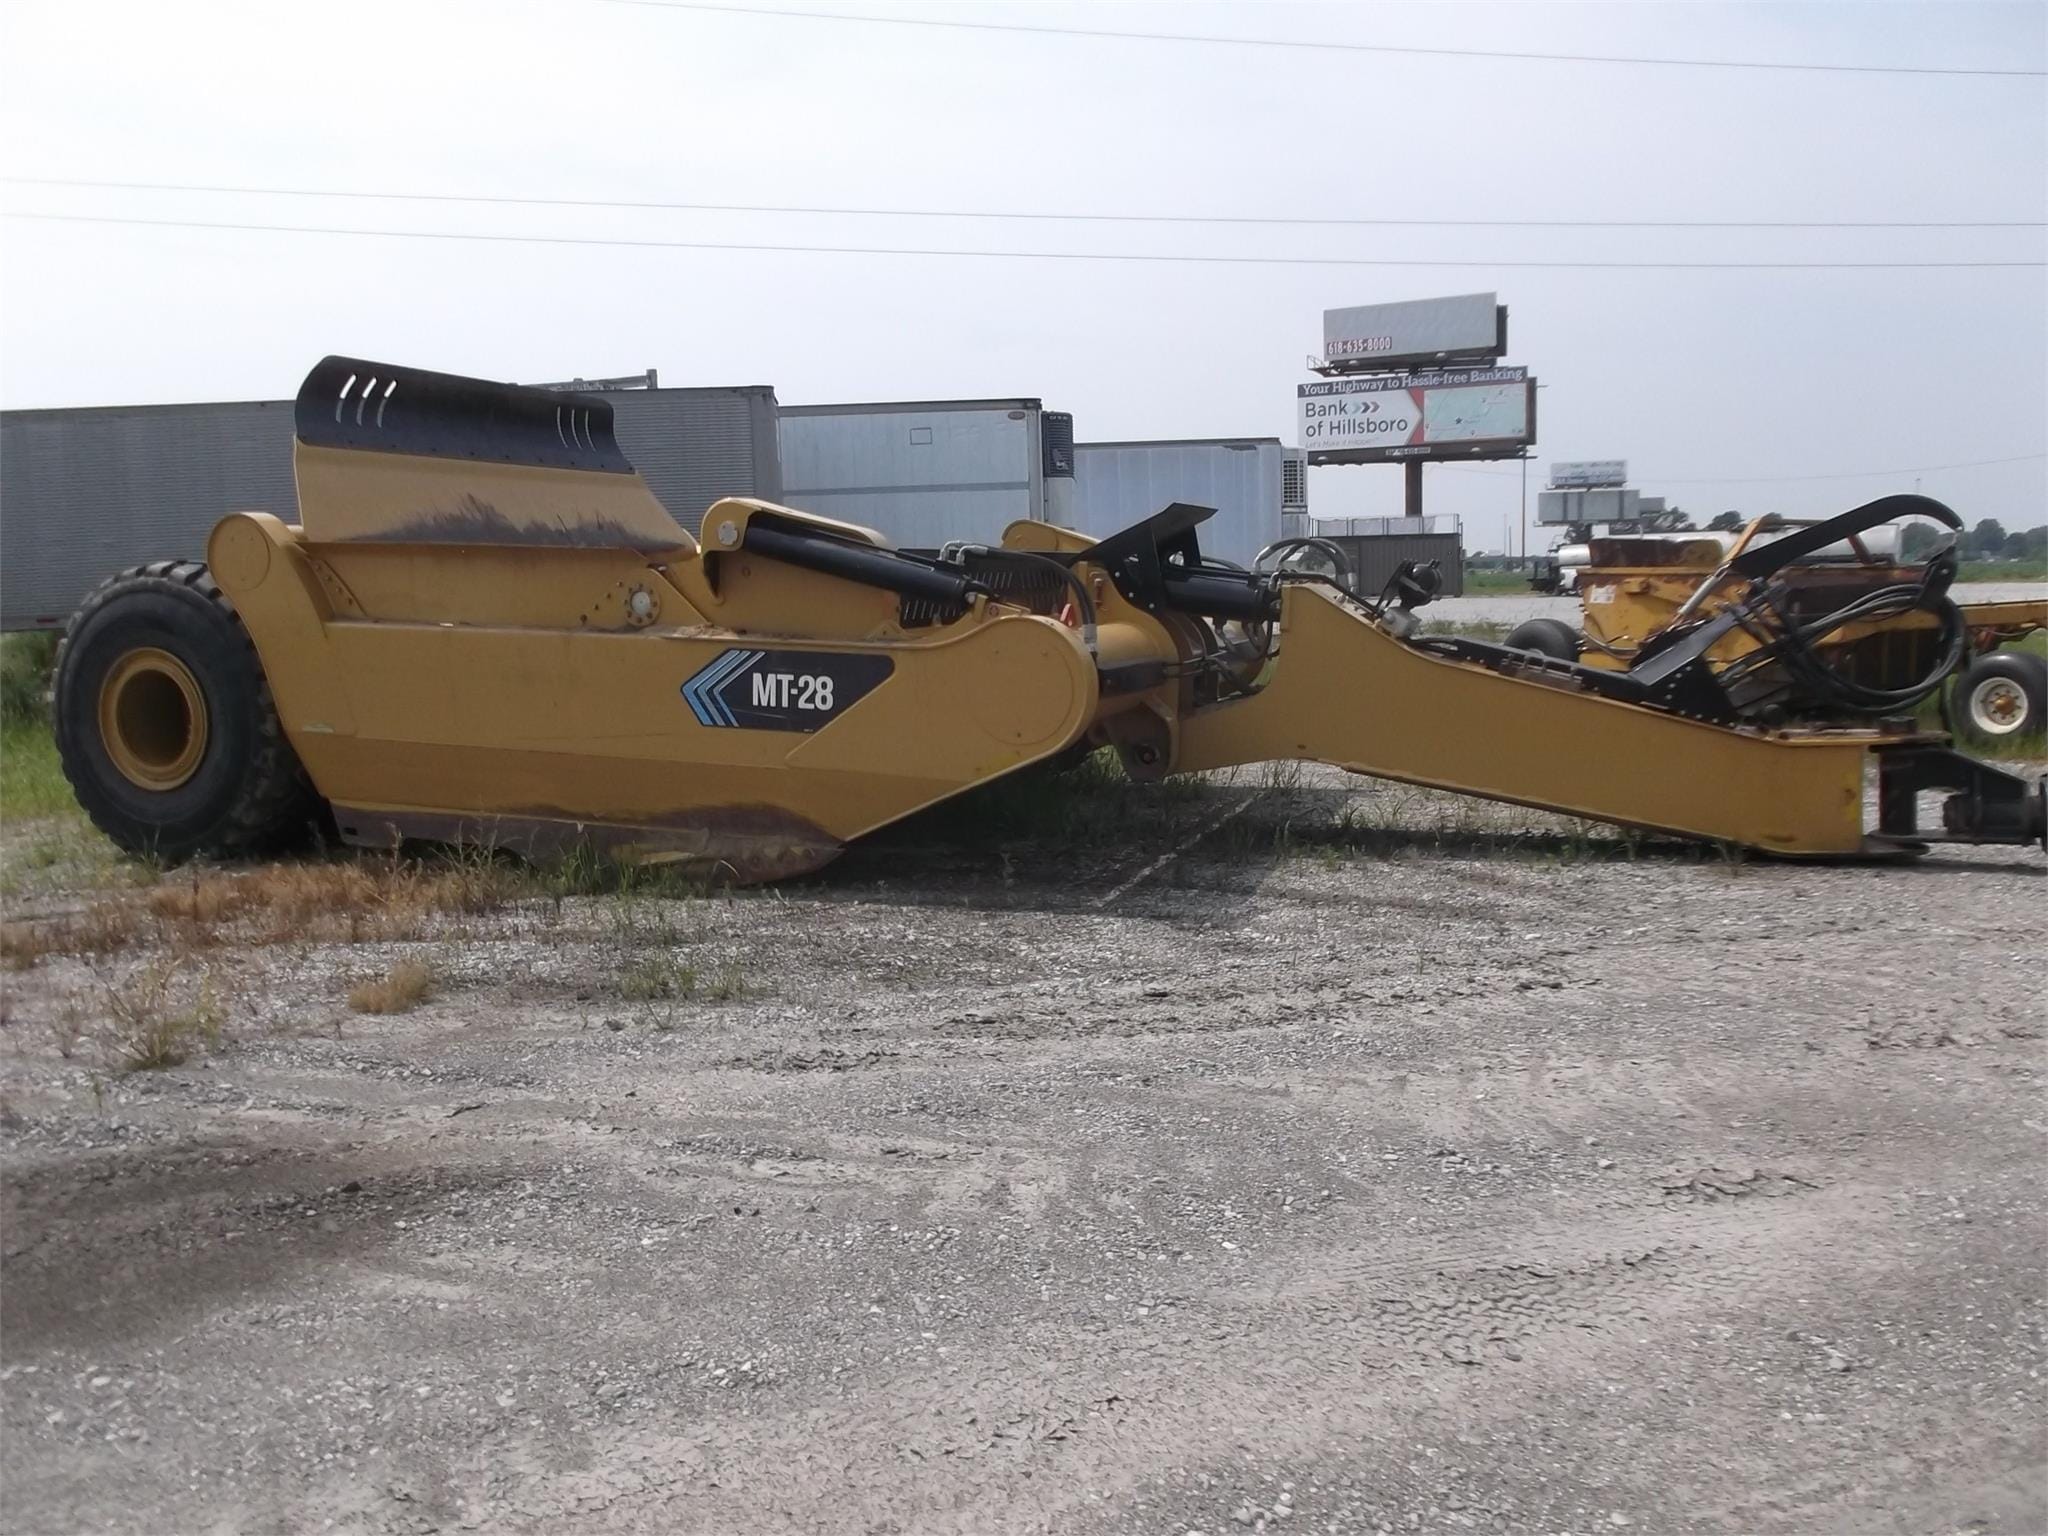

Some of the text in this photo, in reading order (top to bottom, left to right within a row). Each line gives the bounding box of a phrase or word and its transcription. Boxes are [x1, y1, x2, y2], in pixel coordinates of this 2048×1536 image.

[1328, 337, 1391, 354] 618-635-8000
[1303, 368, 1523, 395] Your Highway to Hassle-free Banking
[1305, 400, 1348, 417] Bank
[1305, 417, 1408, 437] of Hillsboro
[752, 672, 834, 711] MT-28
